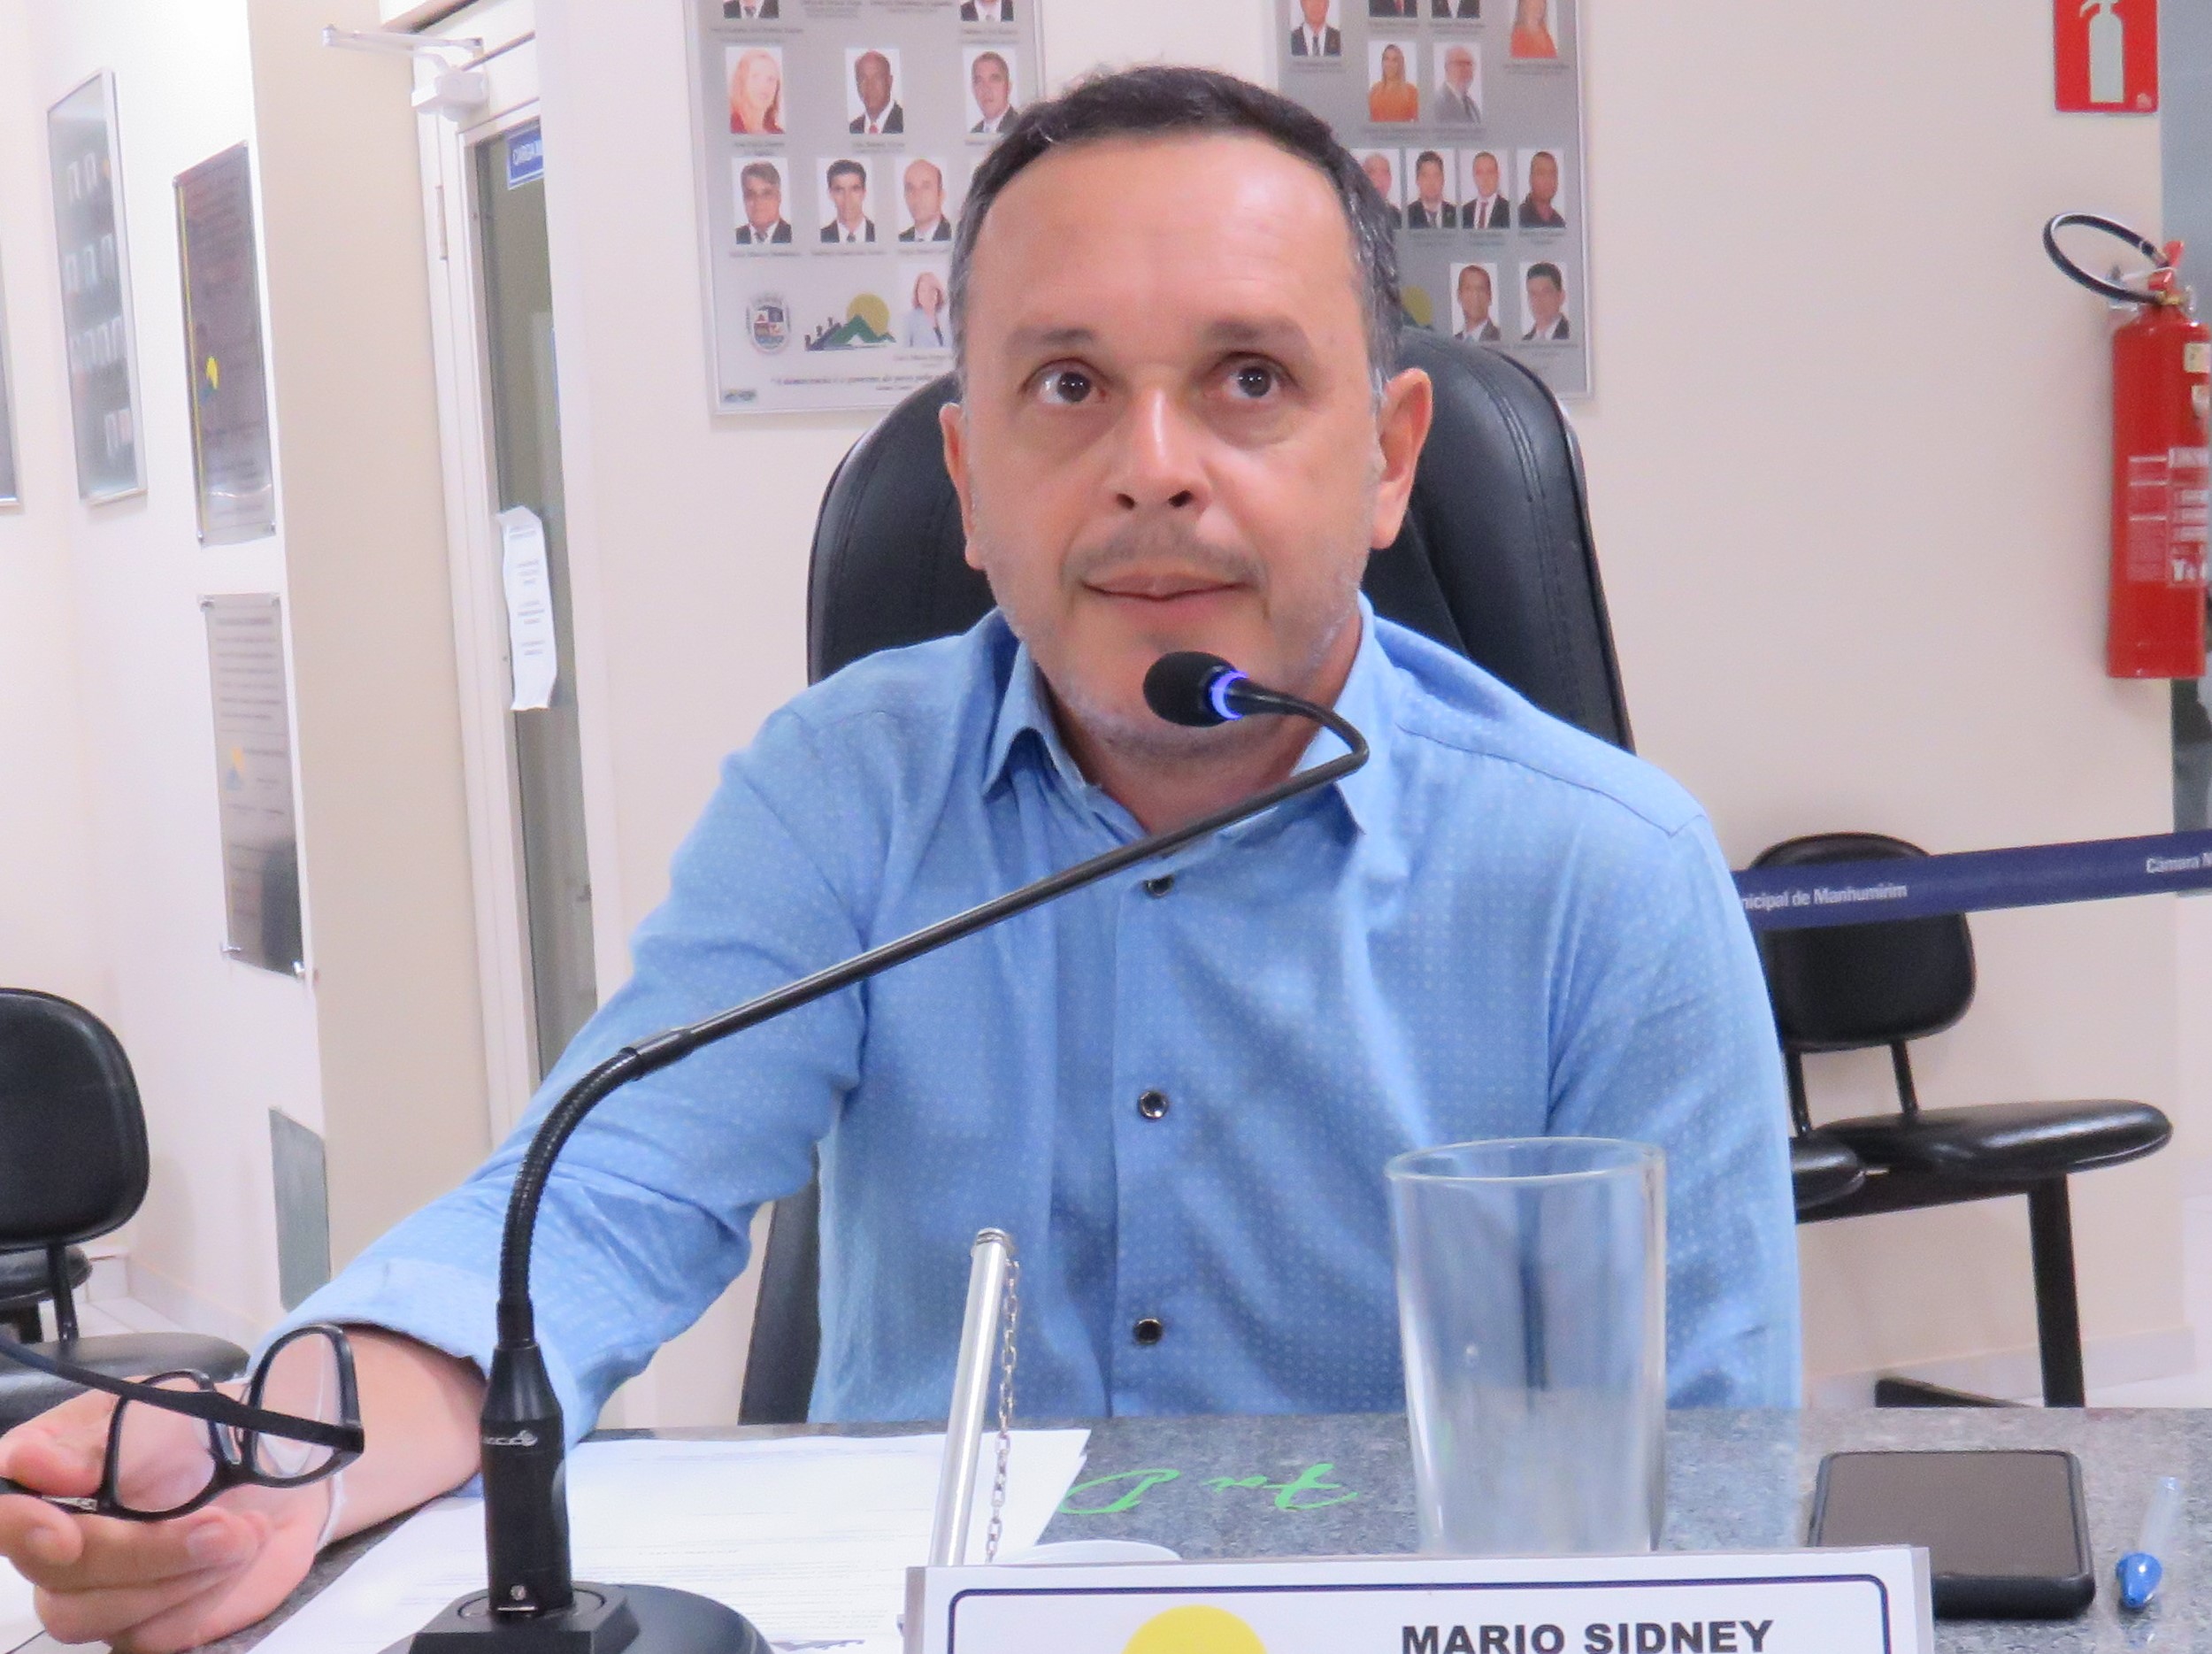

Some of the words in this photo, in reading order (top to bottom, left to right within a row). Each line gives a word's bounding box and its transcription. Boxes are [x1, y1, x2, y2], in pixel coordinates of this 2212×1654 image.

[1792, 889, 1811, 907] de
[1402, 1623, 1565, 1654] MARIO
[1584, 1619, 1774, 1654] SIDNEY
